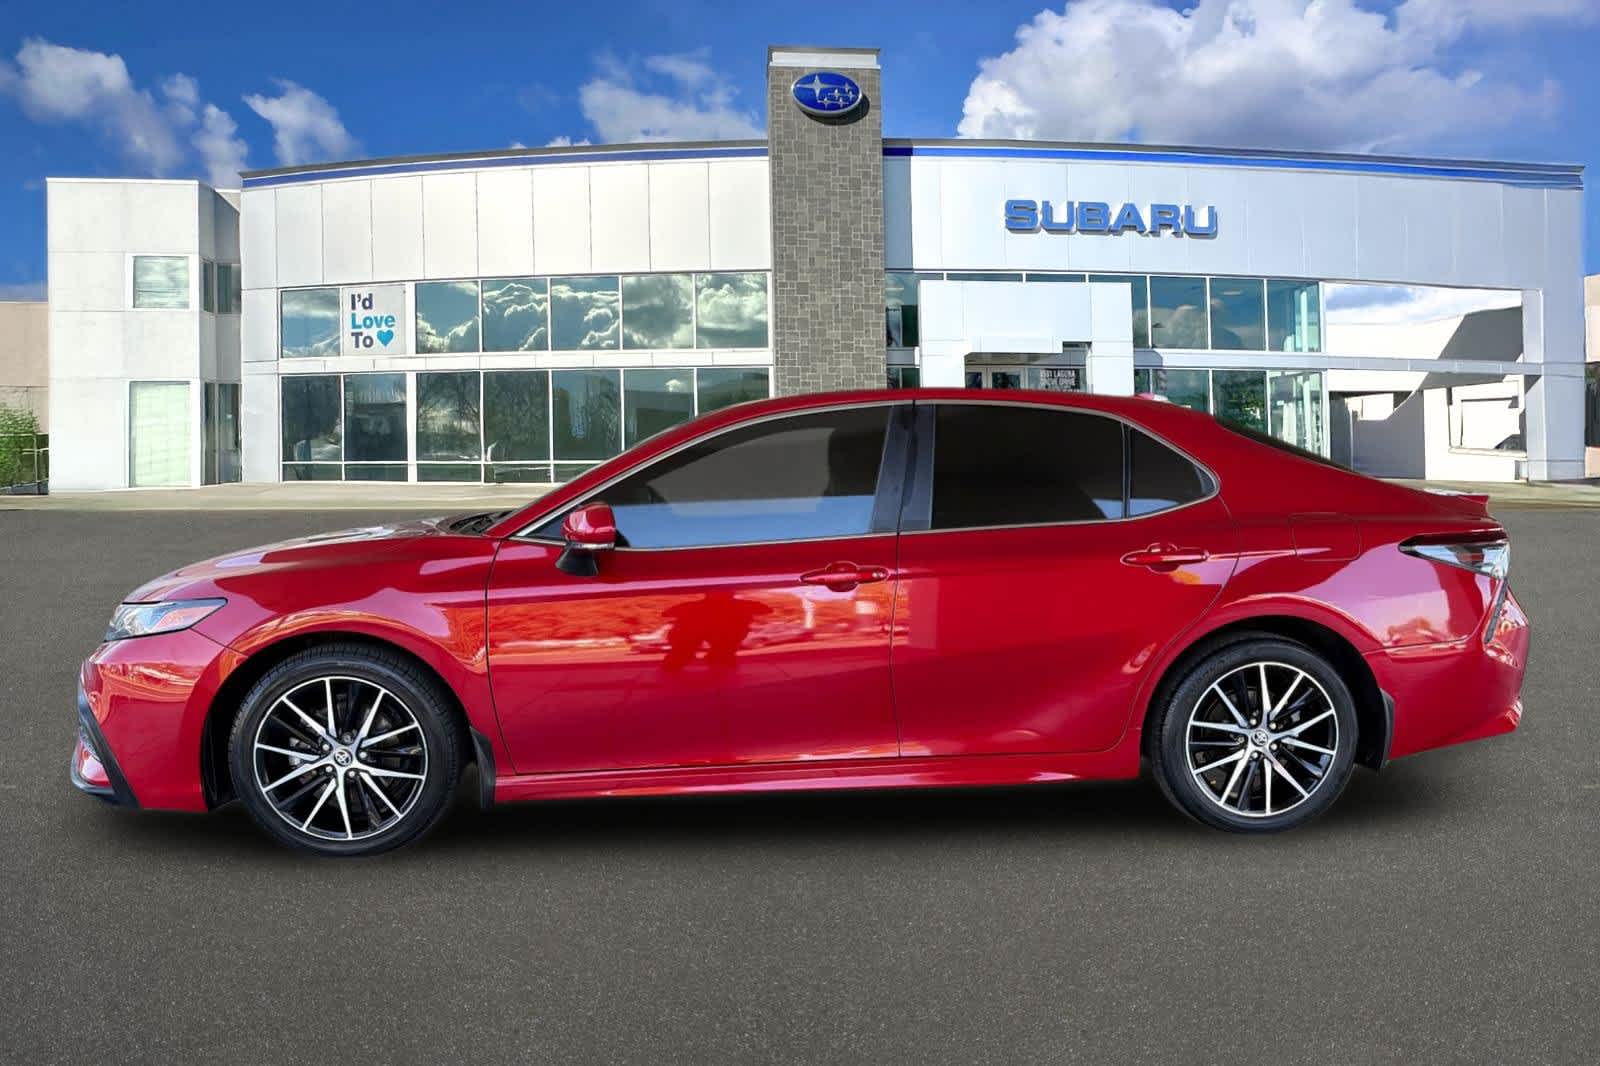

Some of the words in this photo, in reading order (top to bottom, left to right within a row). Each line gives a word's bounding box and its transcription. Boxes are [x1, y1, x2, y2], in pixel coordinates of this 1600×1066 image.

[1004, 199, 1218, 239] SUBARU
[351, 293, 373, 310] I'd
[351, 313, 396, 329] Love
[351, 332, 374, 348] To
